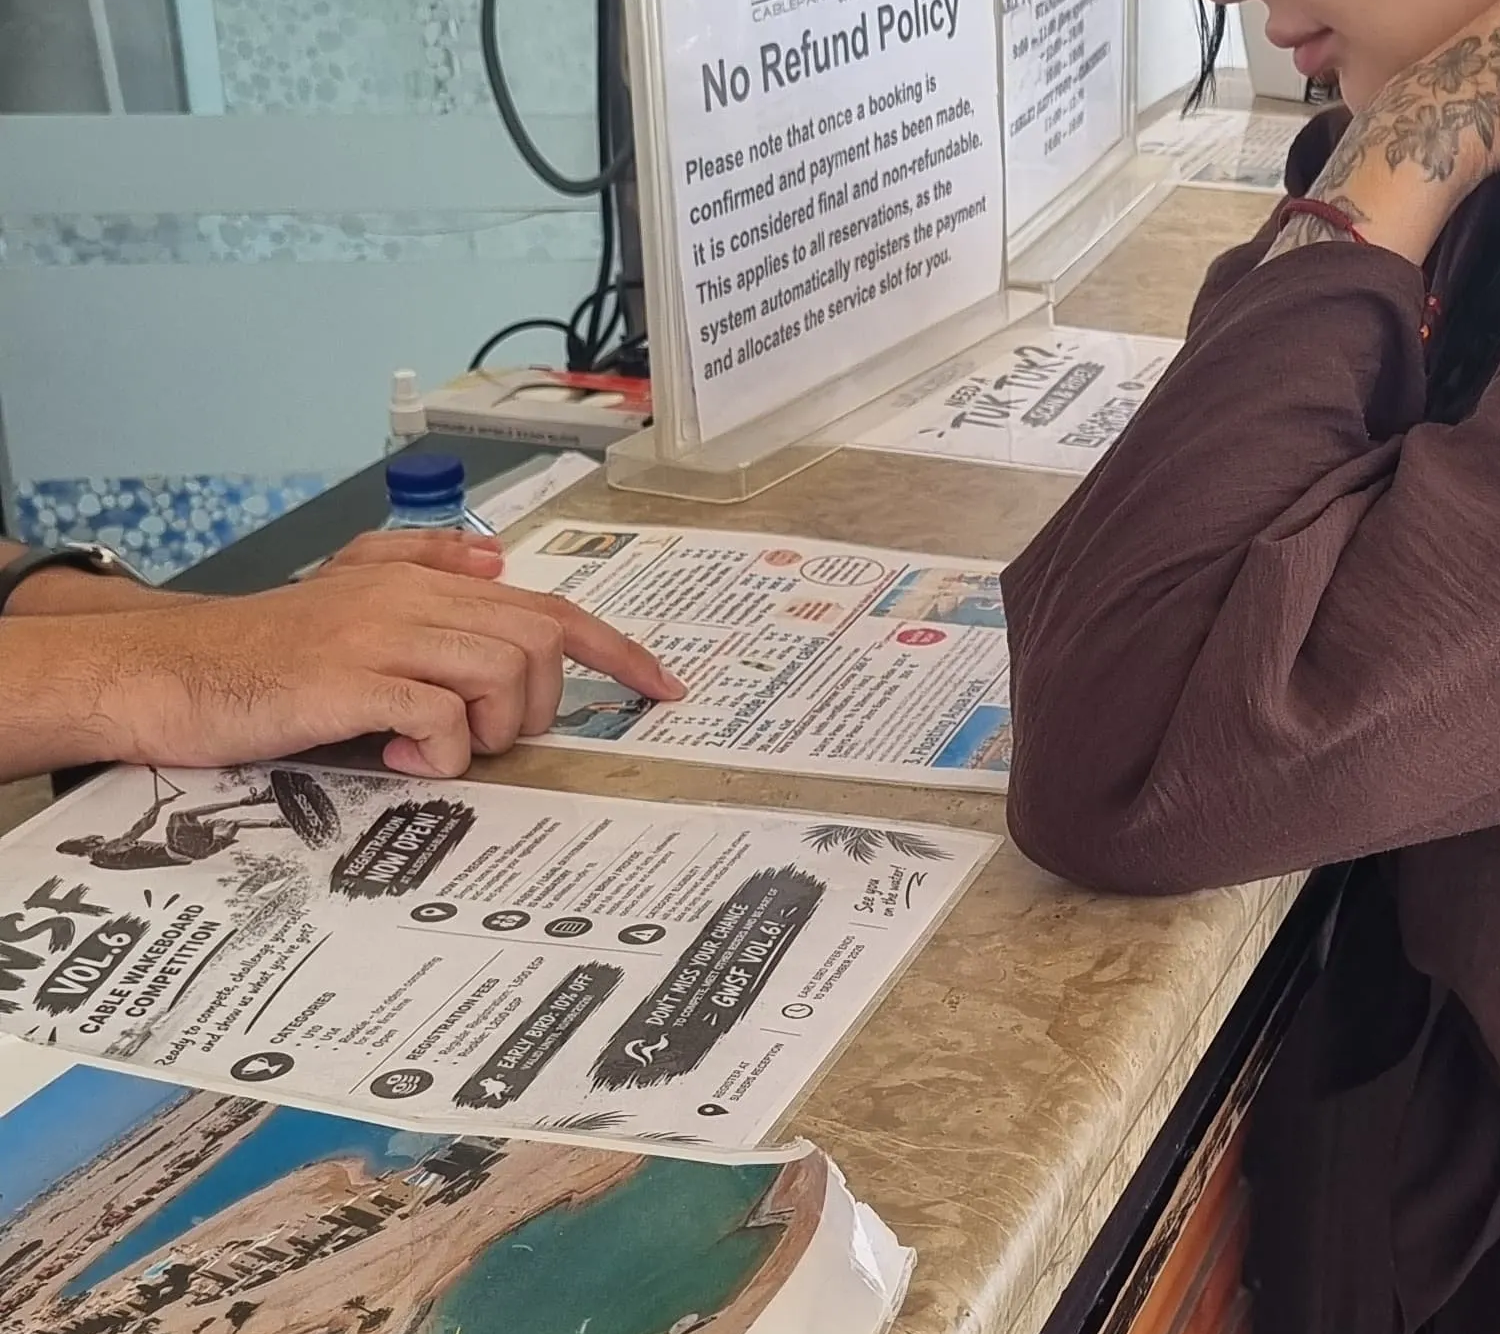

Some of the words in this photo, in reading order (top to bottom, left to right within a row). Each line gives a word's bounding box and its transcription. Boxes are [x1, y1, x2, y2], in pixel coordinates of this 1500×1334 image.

[702, 59, 750, 112] No
[760, 12, 869, 93] Refund
[685, 150, 744, 185] Please
[749, 134, 783, 163] note
[787, 121, 815, 149] that
[818, 108, 853, 135] once
[857, 103, 865, 120] a
[869, 82, 923, 116] booking
[925, 73, 937, 93] is
[690, 175, 774, 225] confirmed
[779, 161, 806, 191] and
[809, 136, 871, 185] payment
[874, 126, 898, 153] has
[902, 114, 933, 141] been
[936, 96, 975, 128] made,
[693, 243, 705, 267] it
[711, 237, 725, 262] is
[730, 199, 814, 253] considered
[817, 183, 848, 214] final
[852, 171, 879, 199] and
[882, 130, 984, 190] non-refundable.
[696, 275, 732, 305] This
[737, 253, 790, 291] applies
[792, 243, 806, 265] to
[809, 228, 826, 255] all
[828, 198, 913, 249] reservations,
[916, 189, 931, 209] as
[933, 178, 953, 203] the
[700, 305, 756, 345] system
[761, 256, 850, 316] automatically
[854, 232, 910, 271] registers
[913, 221, 933, 243] the
[936, 195, 987, 238] payment
[704, 348, 733, 380] and
[737, 321, 801, 364] allocates
[804, 308, 825, 333] the
[827, 285, 876, 319] service
[879, 269, 902, 296] slot
[906, 260, 923, 282] for
[925, 247, 951, 275] you.
[944, 384, 982, 408] NEED
[951, 393, 1027, 429] TUK
[993, 345, 1074, 391] TUK?
[714, 718, 748, 738] Easy
[735, 699, 766, 717] Ride
[911, 720, 954, 756] Floating
[344, 817, 404, 875] REGISTRATION
[365, 852, 408, 883] NOW
[393, 813, 443, 850] OPEN!
[888, 864, 906, 891] water!
[854, 896, 875, 913] See
[865, 878, 883, 896] you
[881, 892, 898, 905] the
[48, 932, 132, 995] VOL.6
[79, 987, 132, 1034] CABLE
[119, 904, 205, 986] WAKEBOARD
[125, 920, 221, 1018] COMPETITION
[155, 1038, 194, 1065] Ready
[182, 1025, 201, 1035] to
[197, 985, 239, 1023] compete,
[230, 944, 274, 982] challenge
[270, 907, 310, 942] yourself,
[201, 1032, 223, 1052] and
[215, 1008, 242, 1031] show
[238, 996, 254, 1007] us
[248, 971, 275, 994] what
[270, 945, 300, 971] you've
[296, 923, 317, 944] got?
[645, 994, 681, 1025] DON'T
[670, 969, 700, 994] MISS
[689, 941, 721, 966] YOUR
[711, 903, 748, 939] CHANCE
[712, 966, 751, 1007] GWSF
[739, 921, 785, 963] VOL.6!
[270, 992, 335, 1044] CATEGORIES
[301, 1025, 323, 1039] U10
[319, 1027, 342, 1041] U14
[338, 1021, 370, 1043] Rookie
[353, 1036, 370, 1045] for
[365, 1025, 382, 1035] the
[372, 1029, 398, 1048] Open
[406, 999, 478, 1060] REGISTRATION
[471, 978, 500, 998] FEES
[497, 1038, 534, 1069] EARLY
[525, 1012, 559, 1037] BIRD:
[550, 993, 578, 1010] 10%
[568, 973, 592, 991] OFF
[712, 1070, 743, 1098] REGISTER
[738, 1061, 750, 1070] AT
[729, 1076, 756, 1101] SLIDERS
